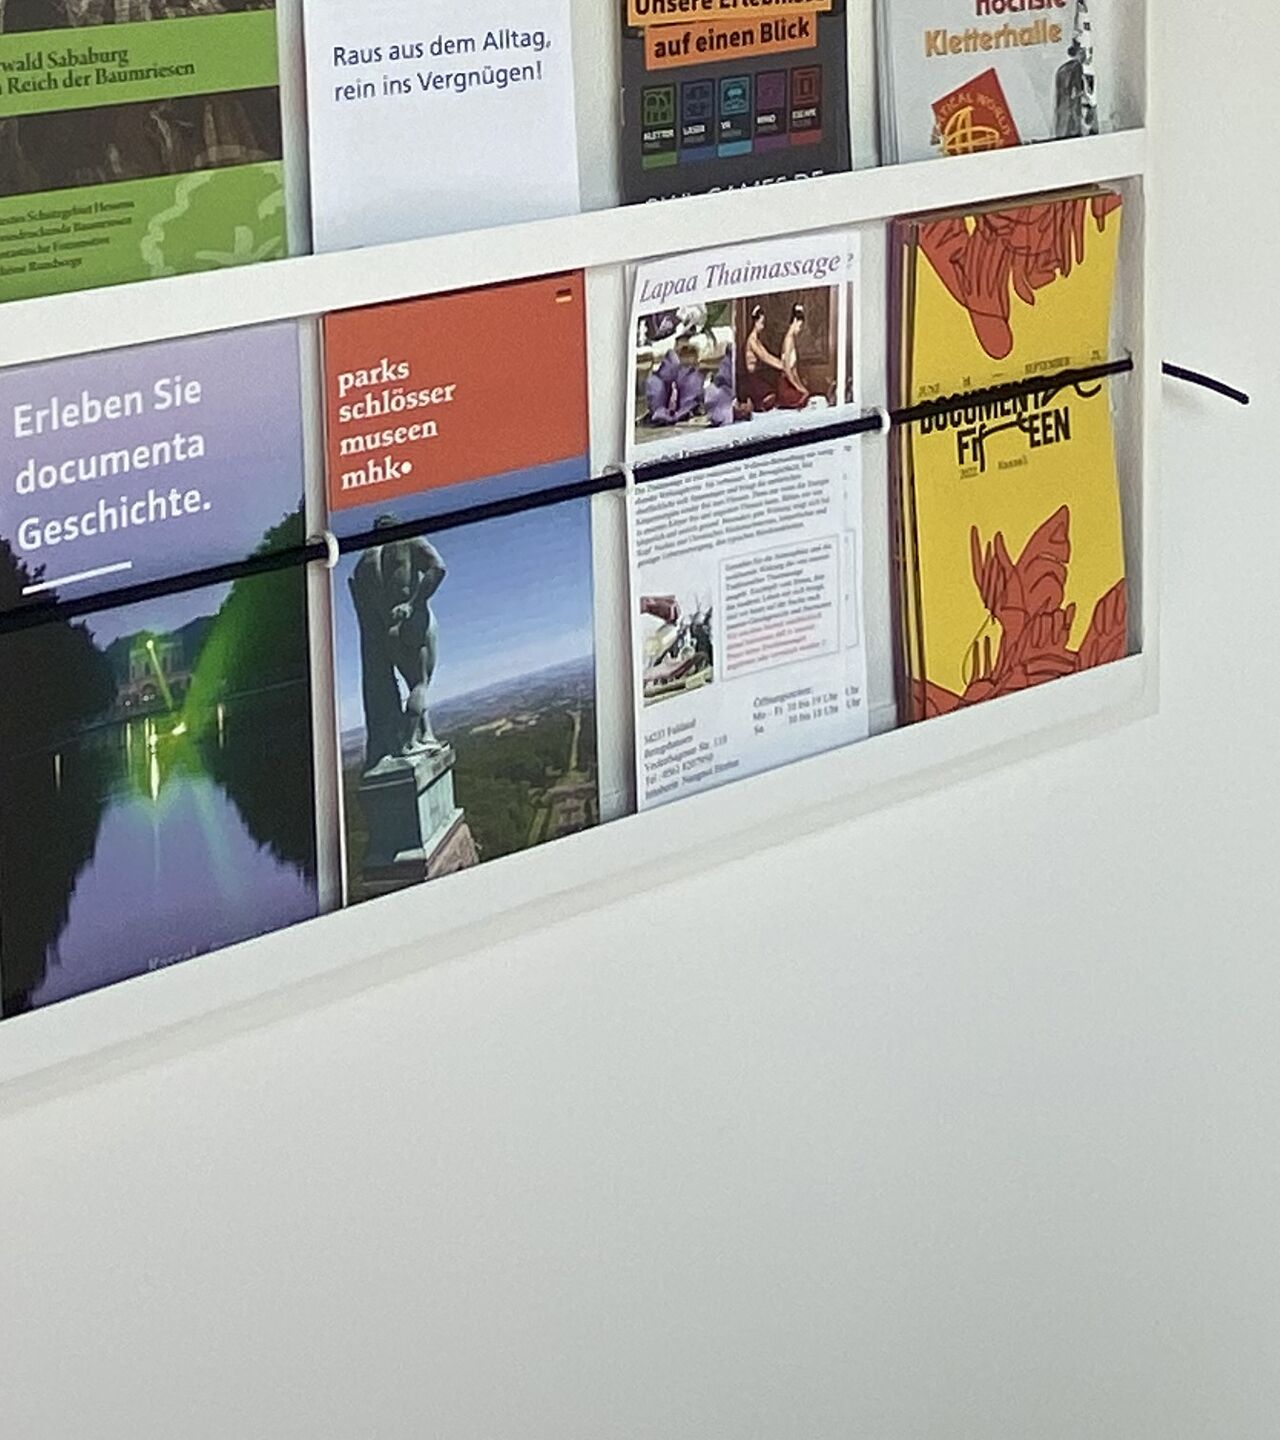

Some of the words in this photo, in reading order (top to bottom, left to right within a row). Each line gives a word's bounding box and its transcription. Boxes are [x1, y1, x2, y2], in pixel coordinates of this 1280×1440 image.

[333, 46, 382, 66] Raus
[388, 42, 424, 60] aus
[429, 36, 476, 56] dem
[482, 29, 551, 51] Alltag,
[654, 32, 691, 58] auf
[696, 28, 755, 52] einen
[760, 16, 810, 43] Blick
[924, 18, 1062, 58] Kletterhalle
[8, 72, 59, 95] Reich
[62, 70, 92, 88] der
[95, 61, 196, 85] Baumriesen
[47, 46, 129, 72] Sababurg
[335, 75, 375, 102] rein
[383, 74, 412, 96] ins
[417, 60, 542, 93] Vergnügen!
[639, 274, 698, 305] Lapaa
[705, 255, 841, 289] Thaimassage
[337, 358, 410, 398] parks
[13, 390, 143, 438] Erleben
[154, 375, 202, 411] Sie
[339, 383, 456, 423] schlösser
[340, 420, 439, 457] museen
[15, 432, 205, 495] documenta
[17, 487, 212, 551] Geschichte.
